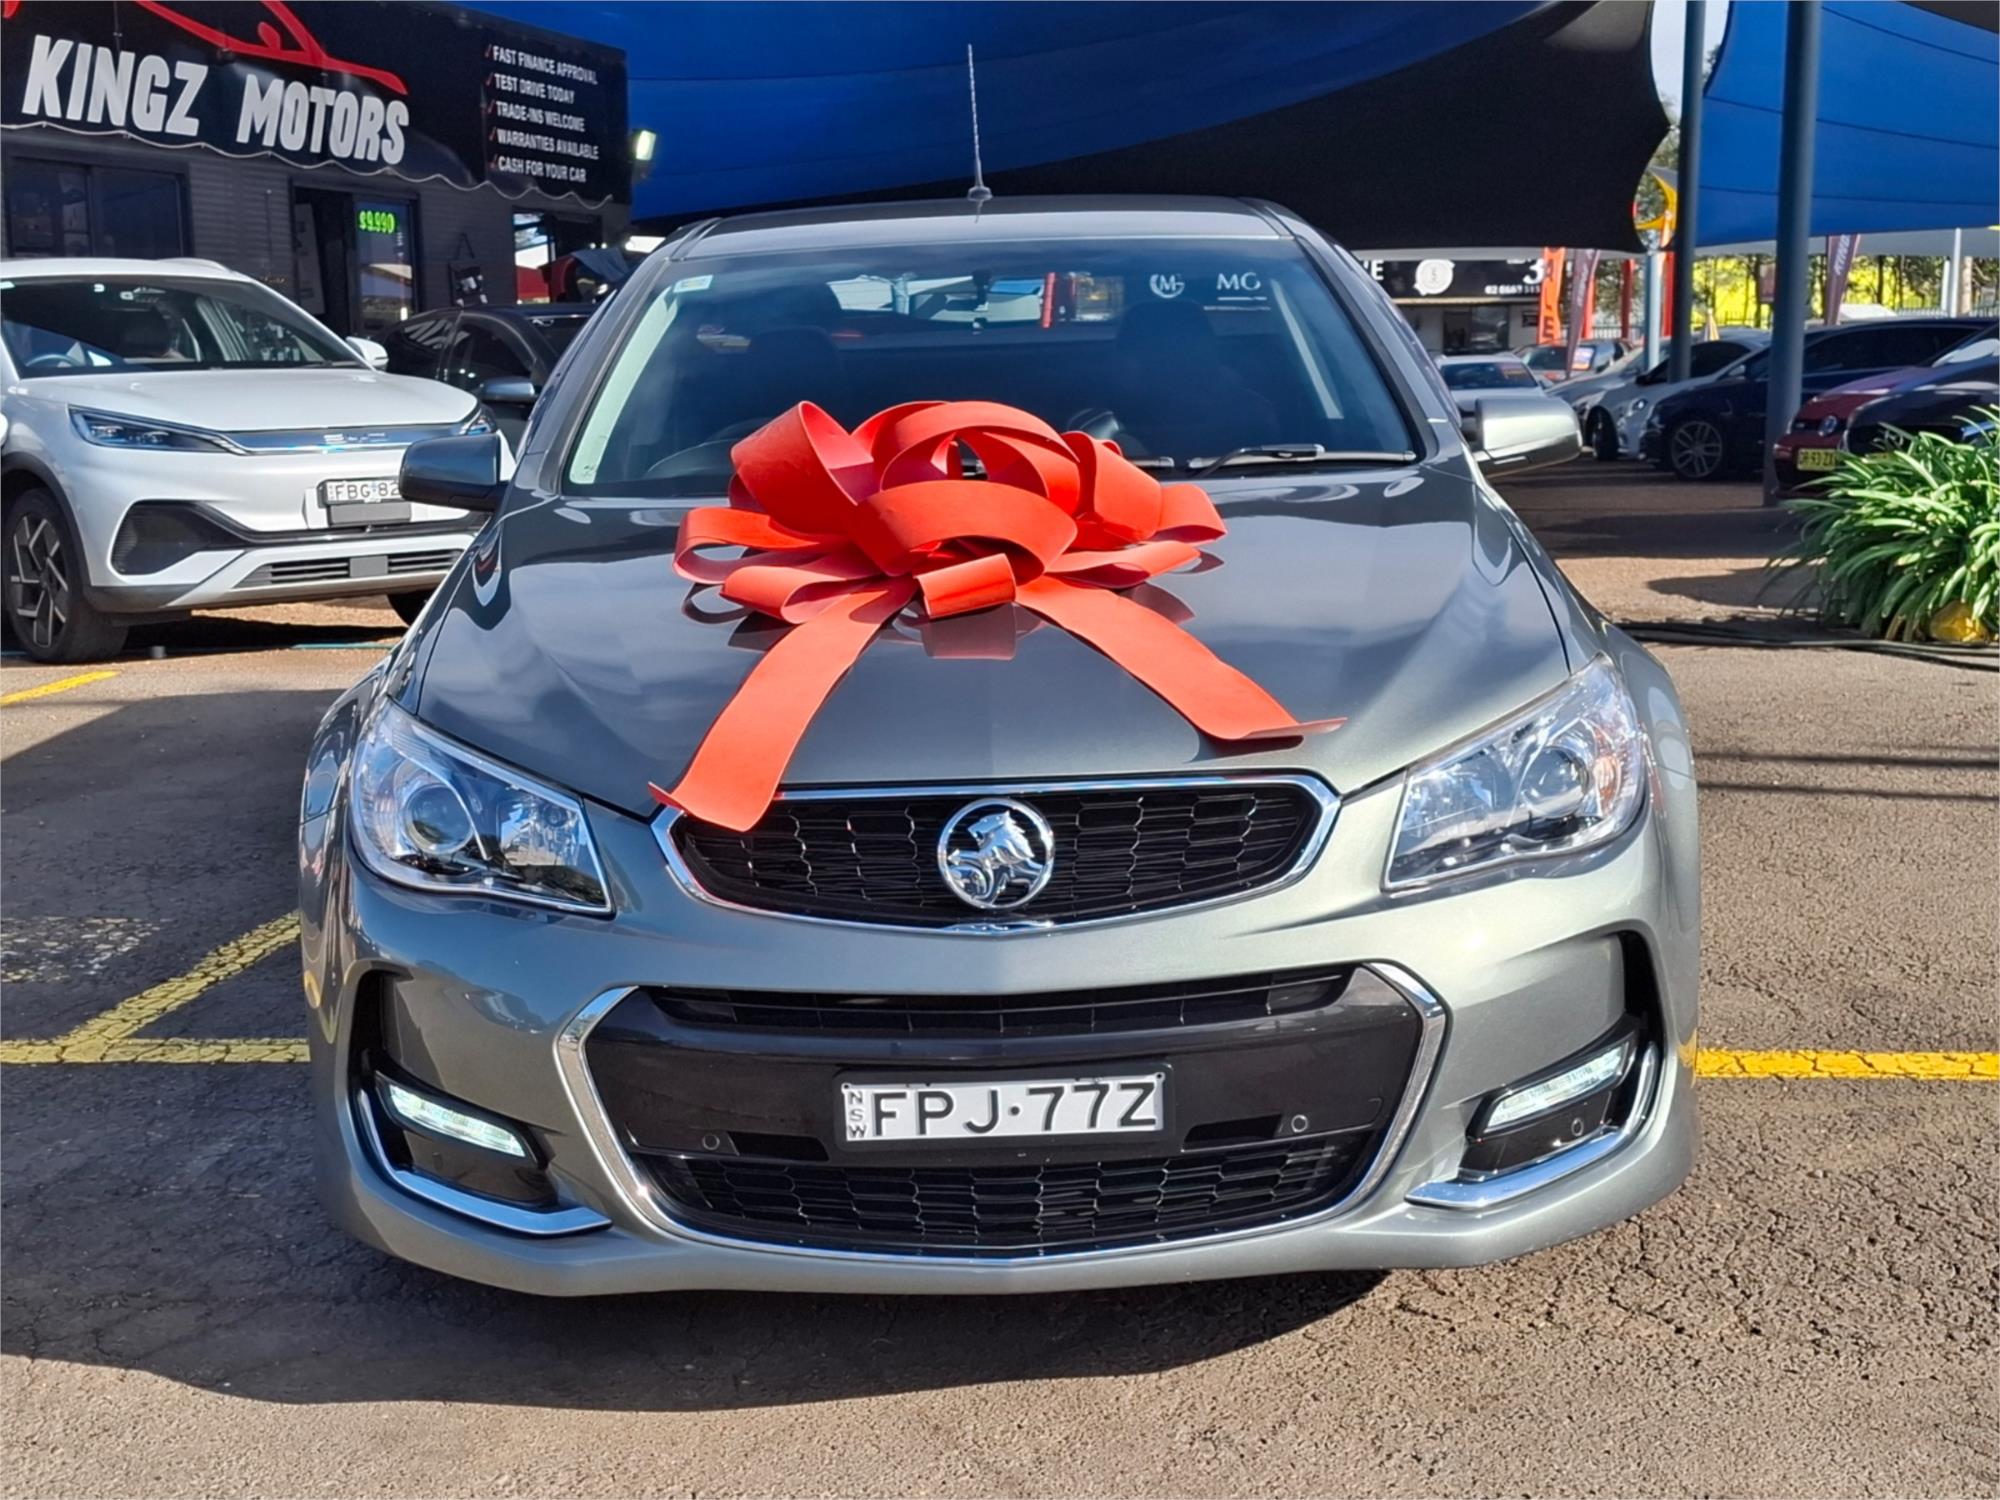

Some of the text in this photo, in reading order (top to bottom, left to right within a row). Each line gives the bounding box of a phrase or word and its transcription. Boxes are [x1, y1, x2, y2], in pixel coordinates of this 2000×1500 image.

[493, 45, 598, 85] FAST FINANCE APPROVAL
[22, 34, 409, 165] KINGZ MOTORS
[494, 73, 575, 104] TEST DRIVE TODAY
[496, 100, 585, 132] TRADE-INS WELCOME
[497, 128, 599, 160] WARRANTIES AVAILABLE
[498, 156, 587, 182] CASH FOR YOUR CAR
[848, 1090, 866, 1137] NSW
